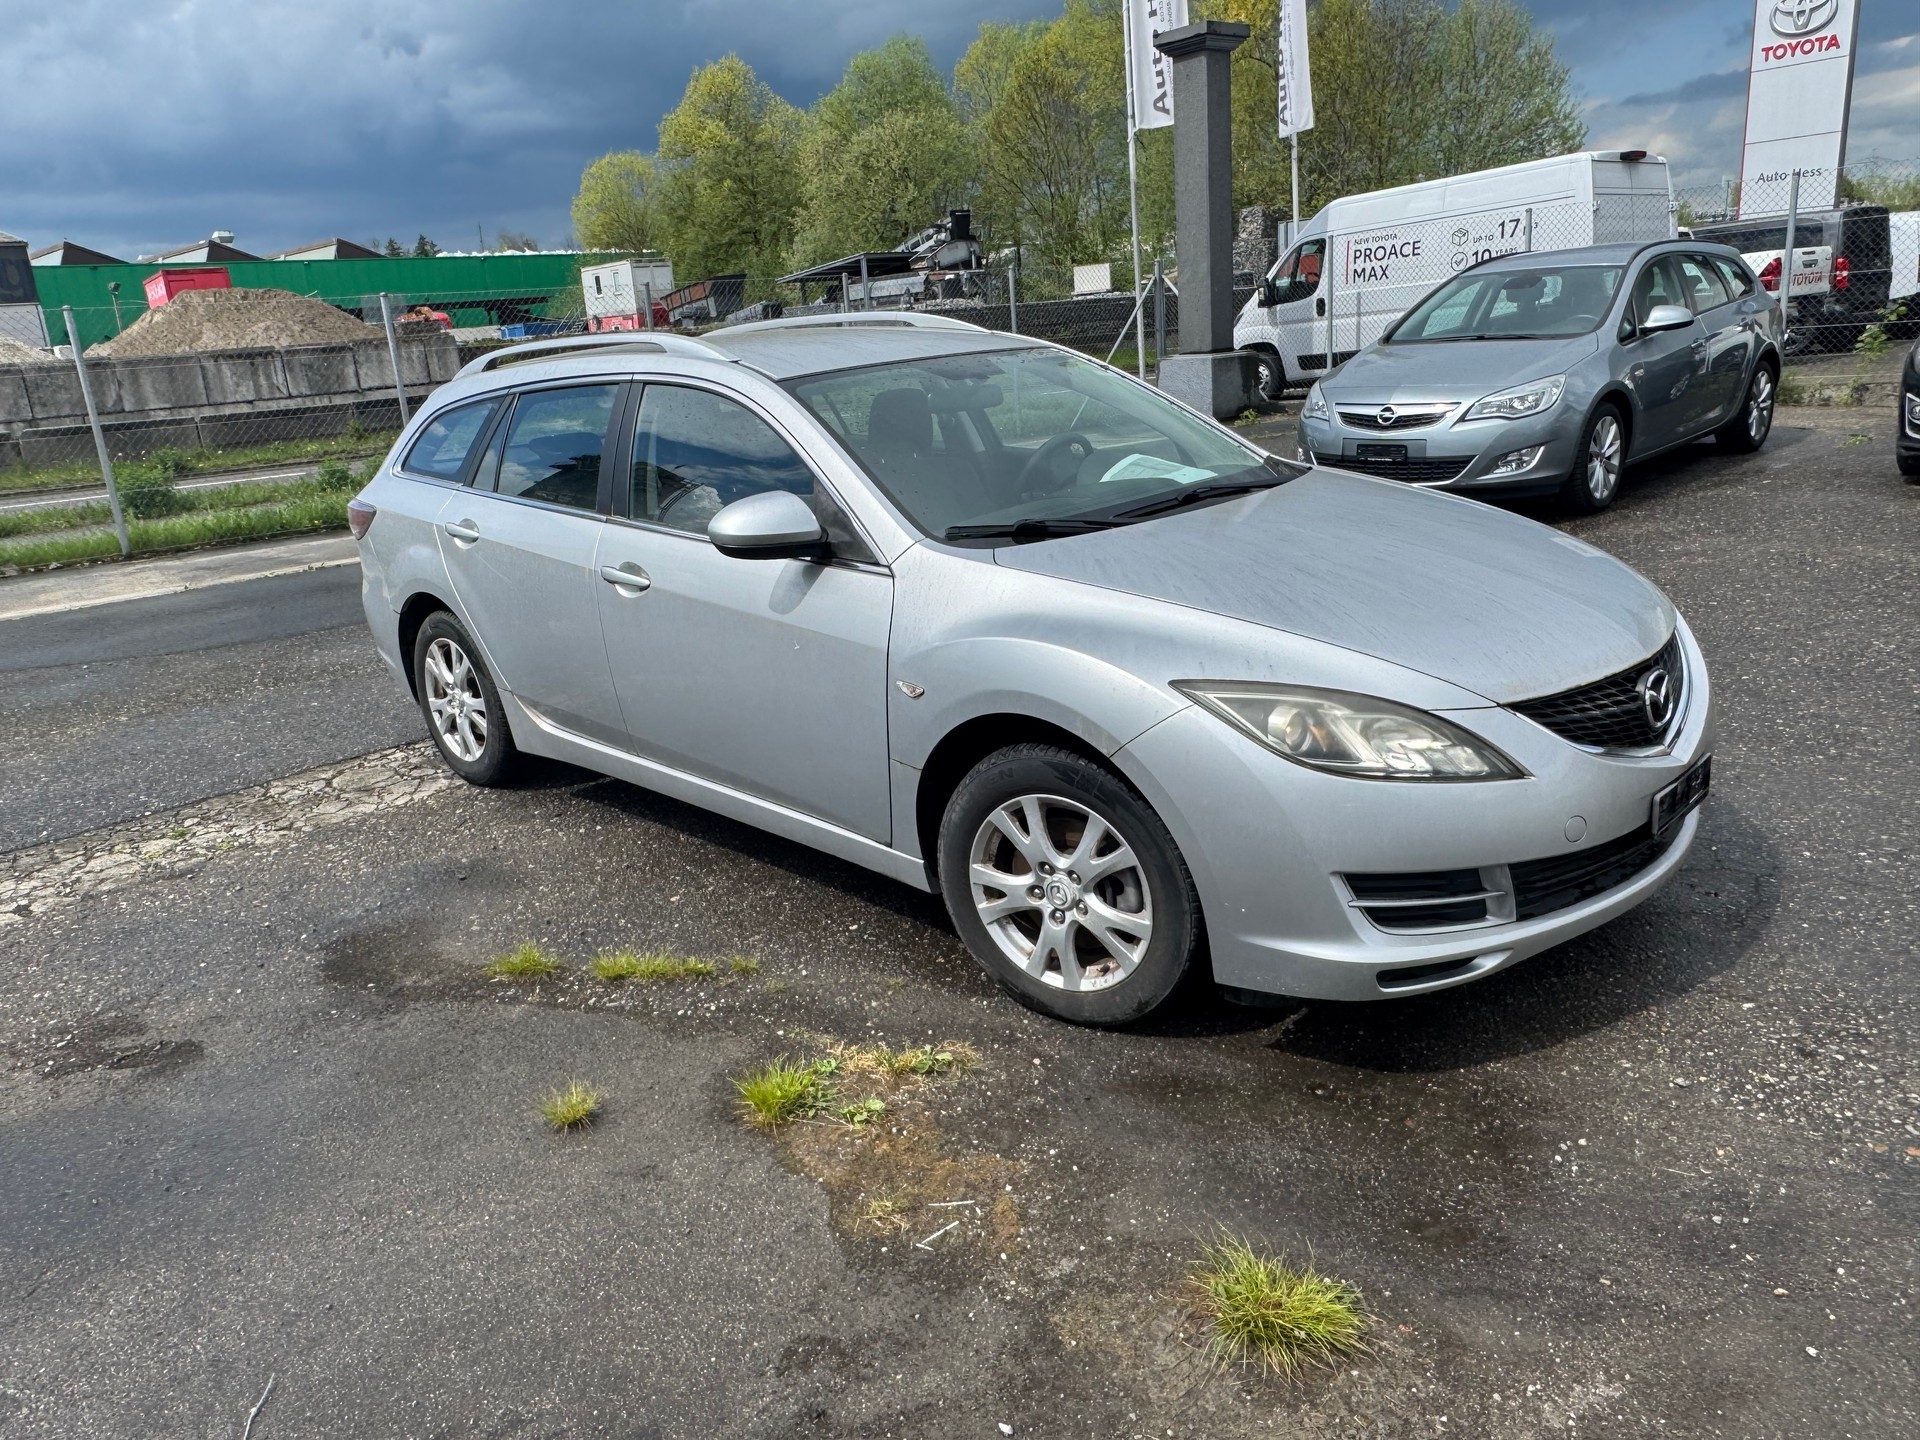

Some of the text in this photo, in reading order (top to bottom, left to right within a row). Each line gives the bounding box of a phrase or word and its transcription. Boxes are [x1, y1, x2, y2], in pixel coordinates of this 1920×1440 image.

[1761, 34, 1840, 62] TOYOTA
[1755, 172, 1788, 184] Auto
[1371, 233, 1398, 243] TOYOTA
[1498, 218, 1520, 239] 17
[1353, 240, 1421, 265] PROACE
[1353, 264, 1389, 284] MAX
[1792, 271, 1823, 286] TOYOTA
